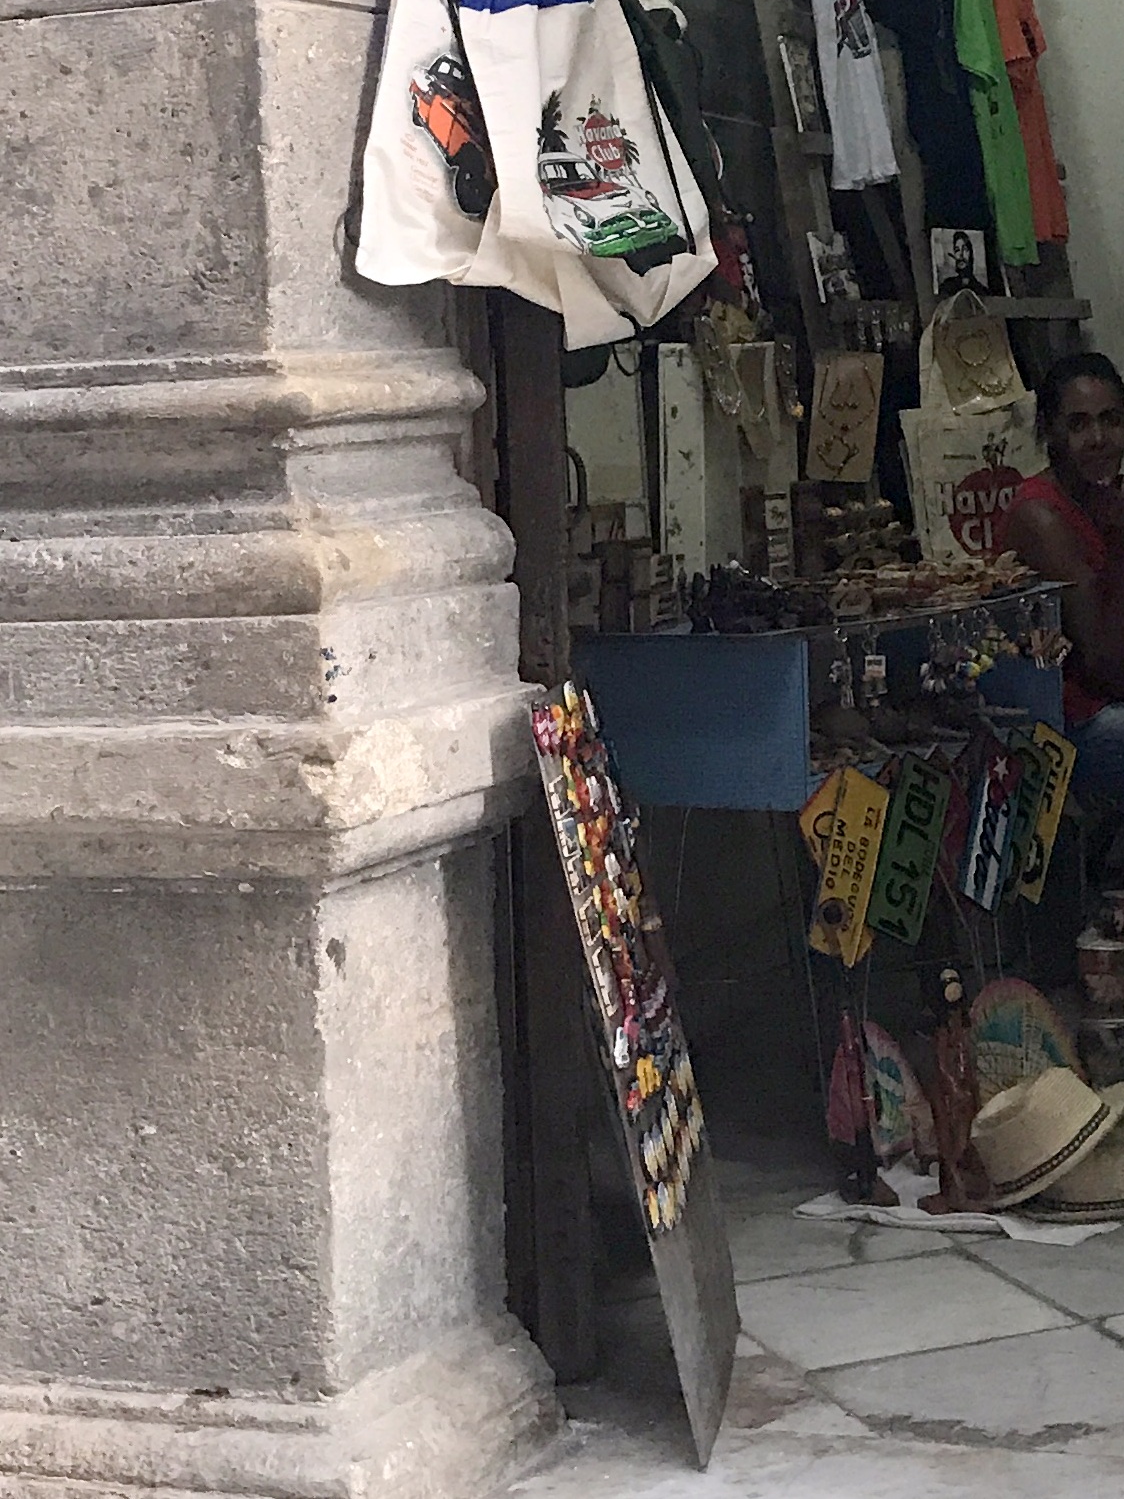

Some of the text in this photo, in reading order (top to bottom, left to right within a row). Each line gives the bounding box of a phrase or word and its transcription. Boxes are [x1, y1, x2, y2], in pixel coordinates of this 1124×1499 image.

[573, 123, 623, 148] Havana
[592, 142, 621, 163] Club
[935, 480, 1016, 517] Hava
[892, 762, 941, 849] HDL
[824, 819, 848, 890] MEDIO
[841, 839, 857, 879] DEL
